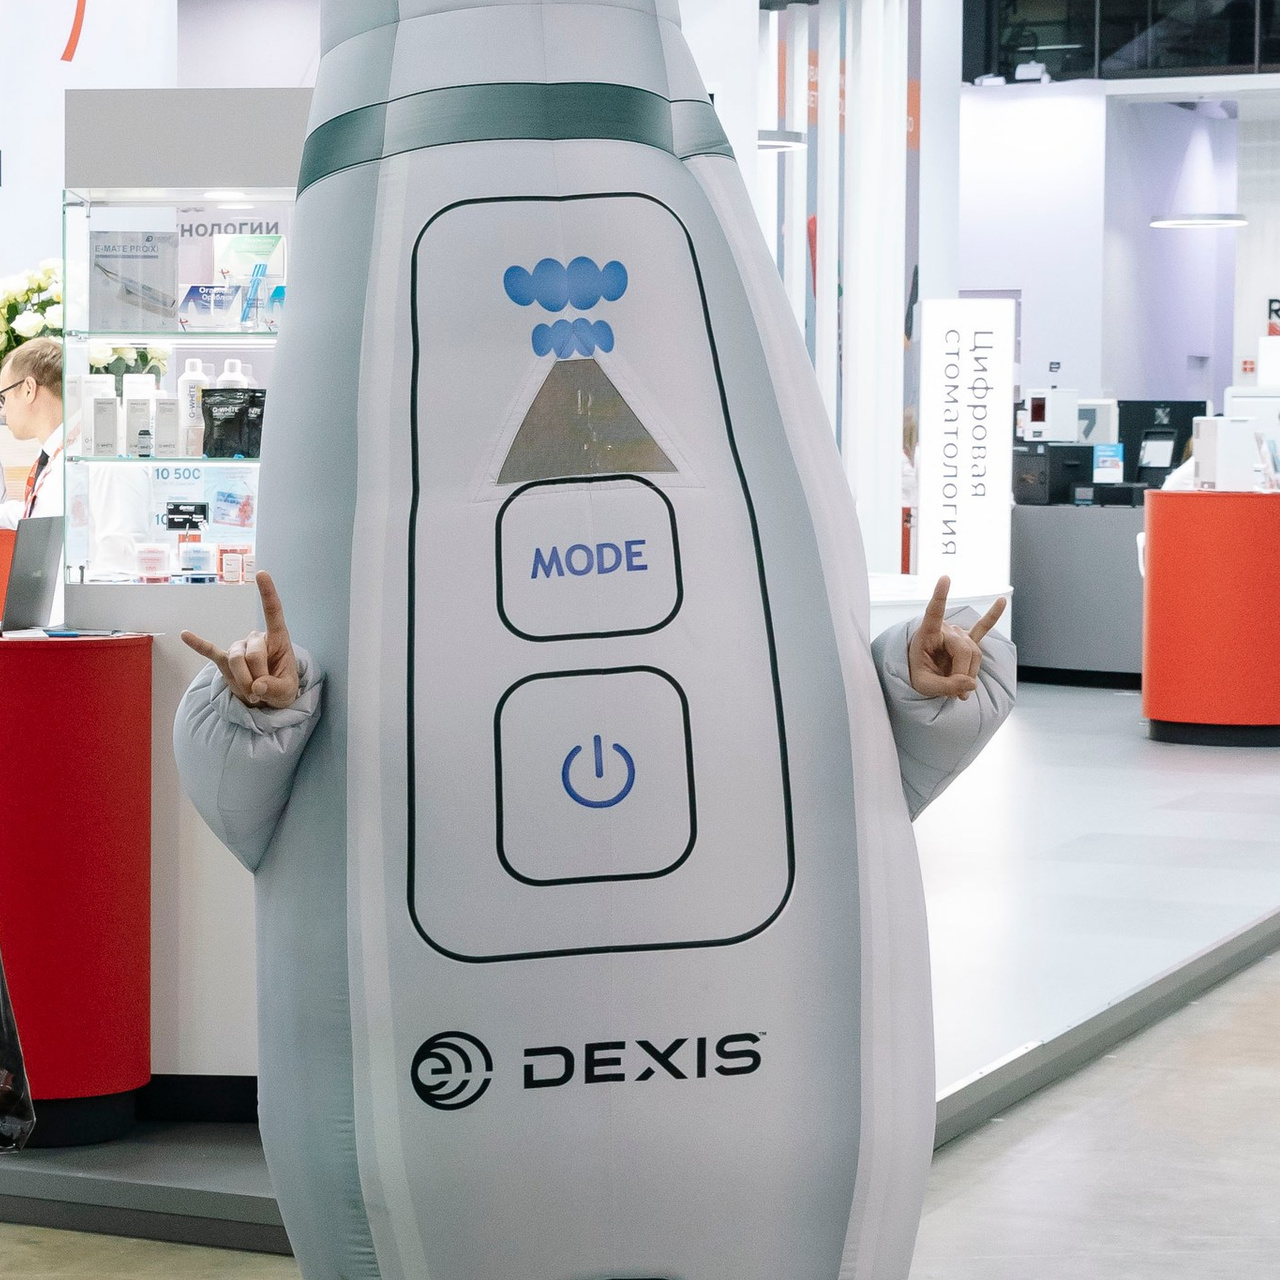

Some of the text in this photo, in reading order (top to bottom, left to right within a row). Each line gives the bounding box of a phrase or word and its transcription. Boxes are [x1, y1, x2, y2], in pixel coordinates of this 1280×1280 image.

[941, 329, 961, 556] стоматология
[967, 331, 995, 498] Цифровая
[530, 539, 649, 580] MODE
[523, 1031, 762, 1090] DEXIS
